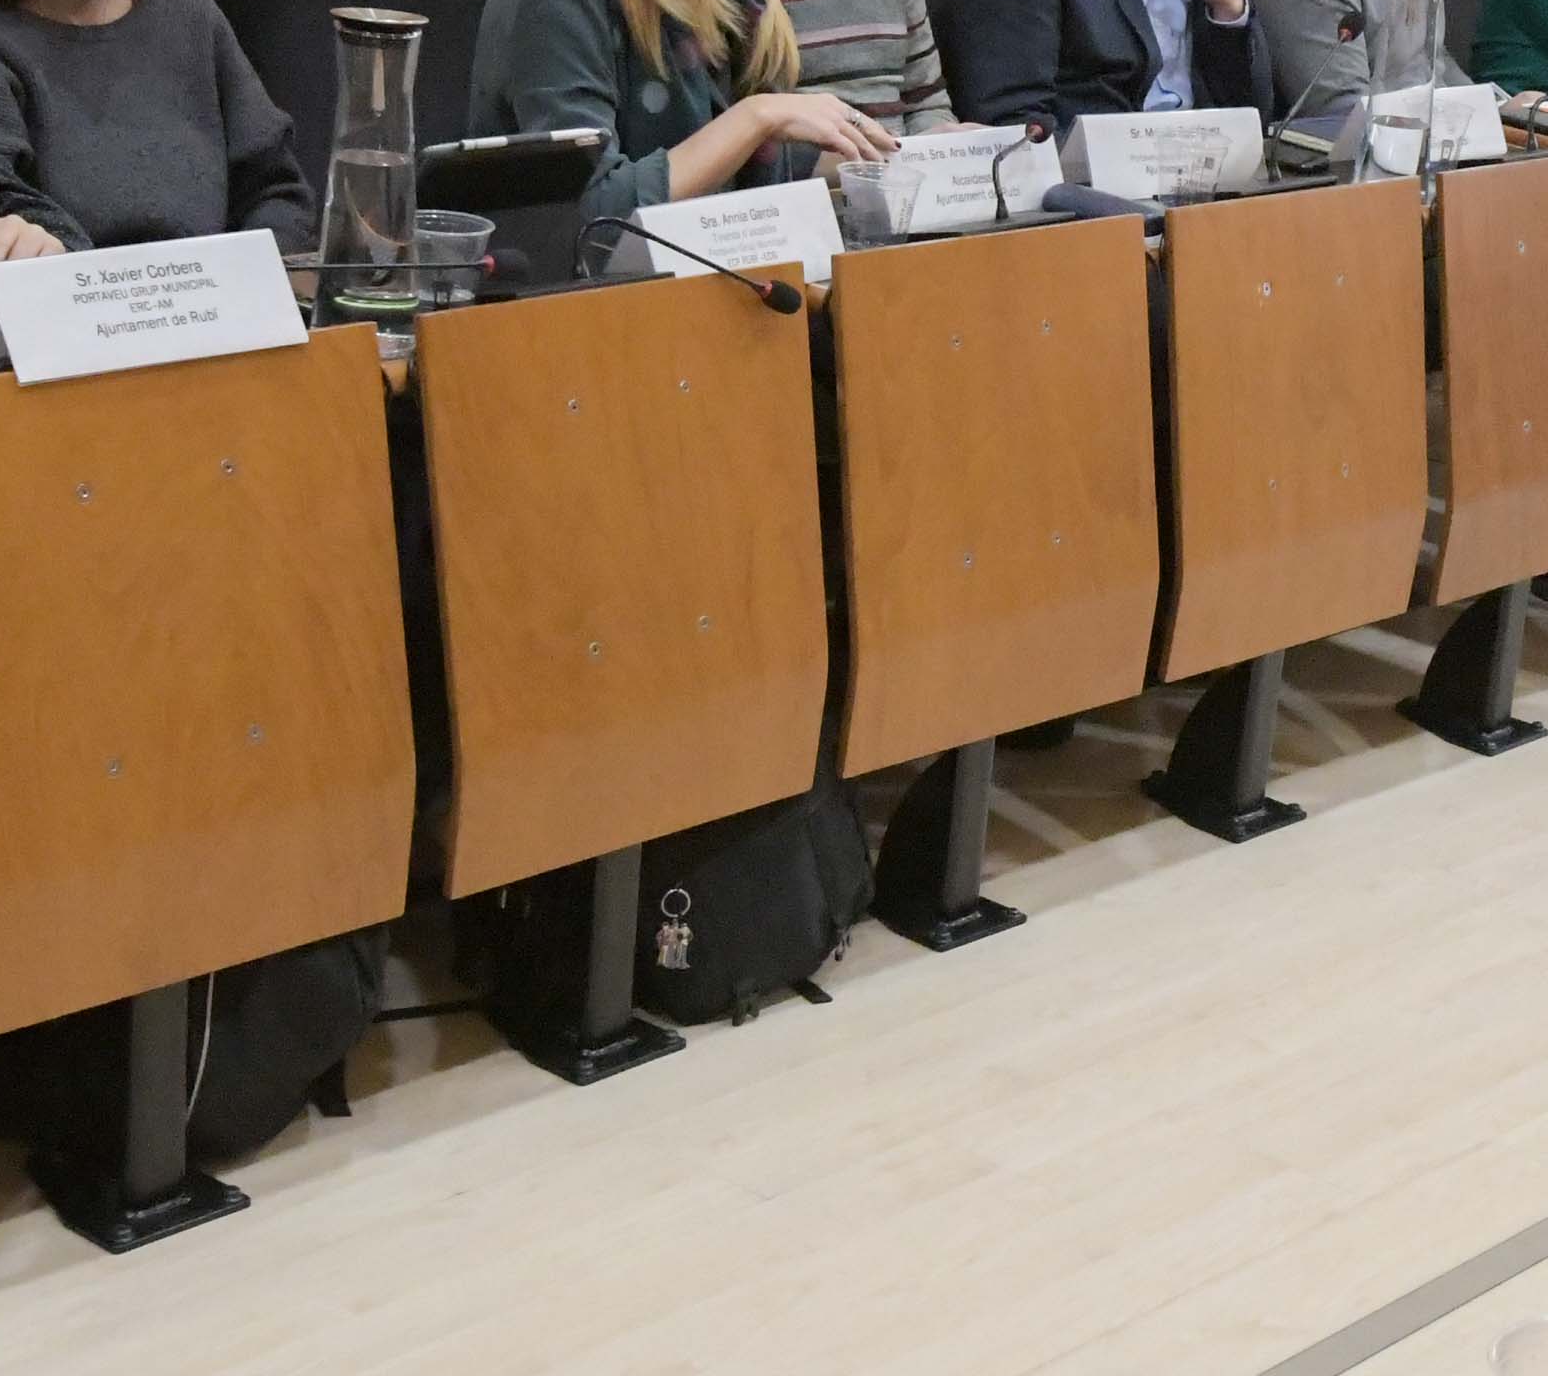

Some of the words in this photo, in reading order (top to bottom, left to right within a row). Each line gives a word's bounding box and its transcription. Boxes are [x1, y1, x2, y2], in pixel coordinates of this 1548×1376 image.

[929, 148, 948, 160] Sra.
[936, 190, 986, 206] Ajuntament
[700, 216, 721, 229] Sra.
[75, 272, 98, 287] Sr.
[99, 268, 143, 284] Xavier
[146, 261, 203, 279] Corbera
[73, 289, 128, 304] PORTAVEU
[130, 285, 159, 298] GRUP
[161, 278, 220, 293] MUNICIPAL
[128, 298, 175, 313] ERC-AM
[97, 316, 170, 339] Ajuntament
[171, 314, 188, 326] de
